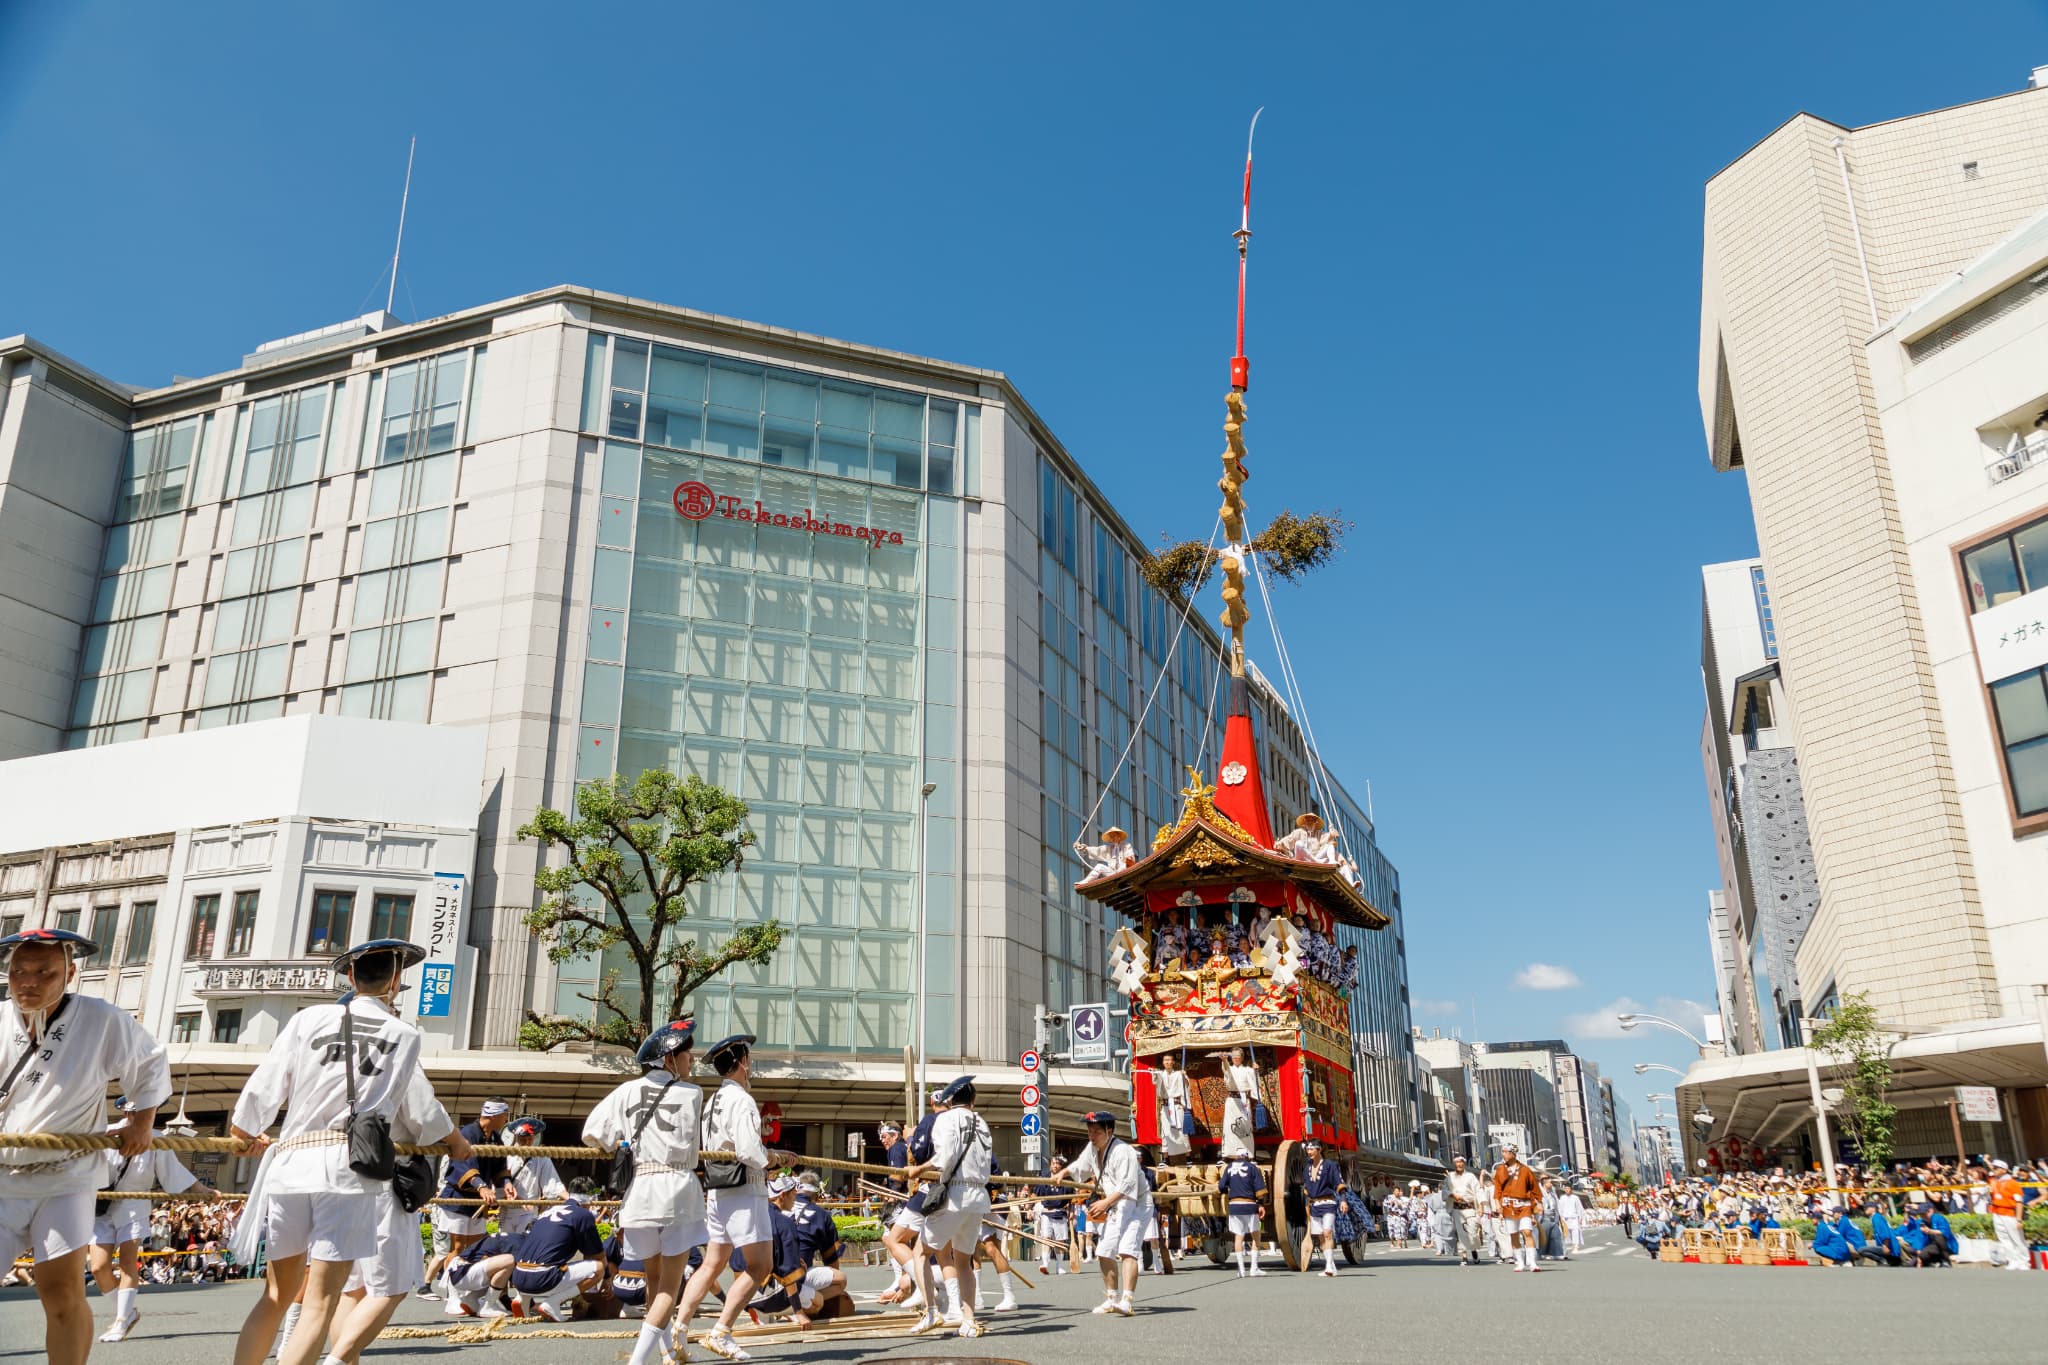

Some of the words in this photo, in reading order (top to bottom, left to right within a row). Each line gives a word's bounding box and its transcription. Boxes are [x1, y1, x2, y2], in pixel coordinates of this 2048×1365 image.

[718, 495, 904, 548] Takashimaya
[430, 896, 447, 958] コンタクト
[446, 897, 458, 944] メガネスーパー
[206, 967, 328, 987] 池善化粧品店
[421, 968, 437, 1014] 買えます
[437, 969, 450, 994] すぐ
[626, 1085, 684, 1132] 長
